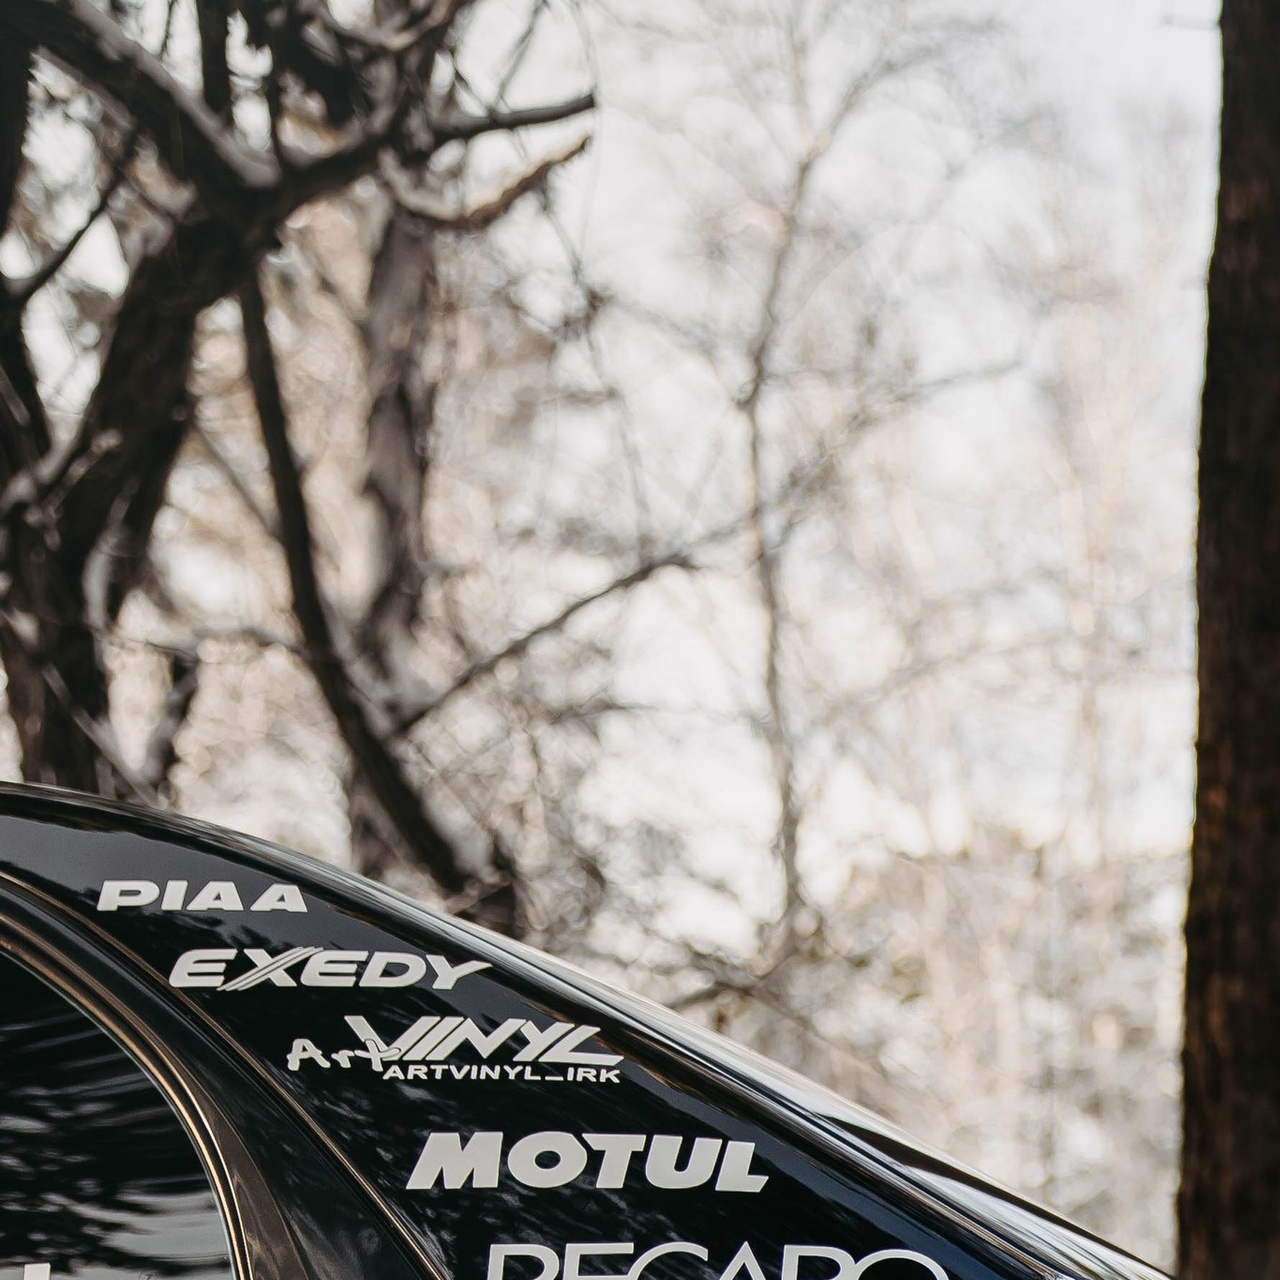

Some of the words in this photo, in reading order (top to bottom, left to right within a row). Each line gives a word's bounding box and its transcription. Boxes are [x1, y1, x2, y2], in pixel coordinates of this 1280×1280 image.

[97, 880, 308, 912] PIAA
[169, 946, 493, 991] EXEDY
[406, 1131, 769, 1193] MOTUL
